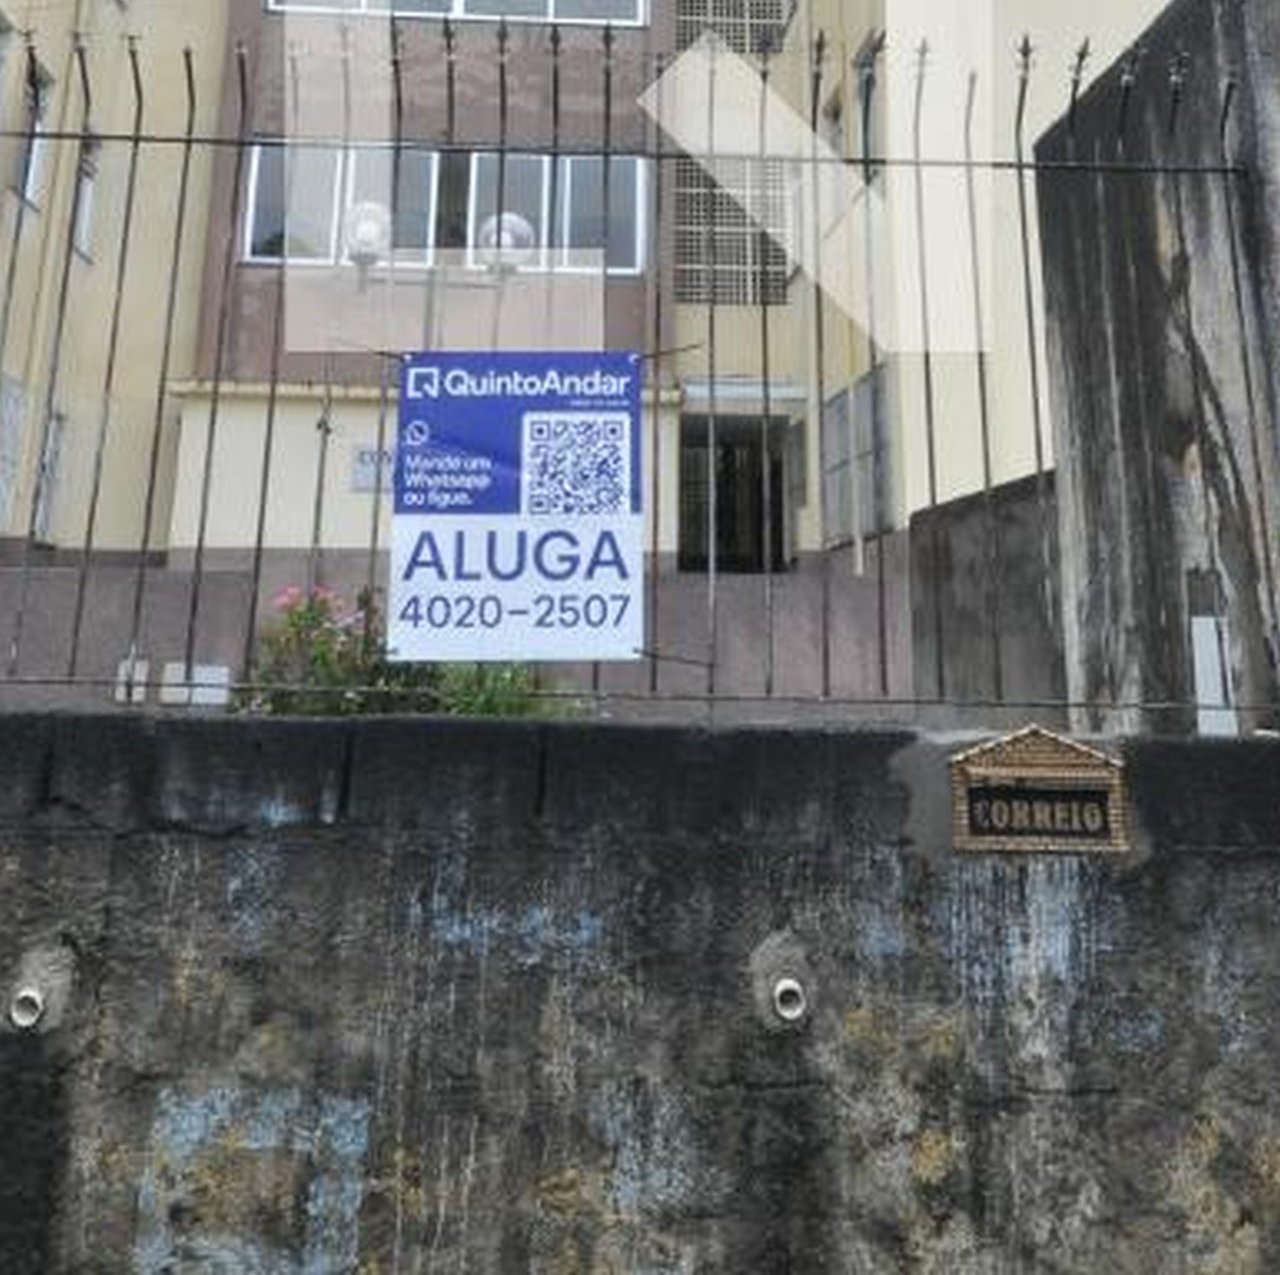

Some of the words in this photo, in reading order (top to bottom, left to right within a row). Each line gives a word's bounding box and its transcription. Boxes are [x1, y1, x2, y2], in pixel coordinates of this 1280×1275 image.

[445, 370, 631, 396] QuintoAndar
[402, 530, 629, 582] ALUGA
[400, 594, 631, 628] 4020-2507
[973, 800, 1103, 831] CORREIO
